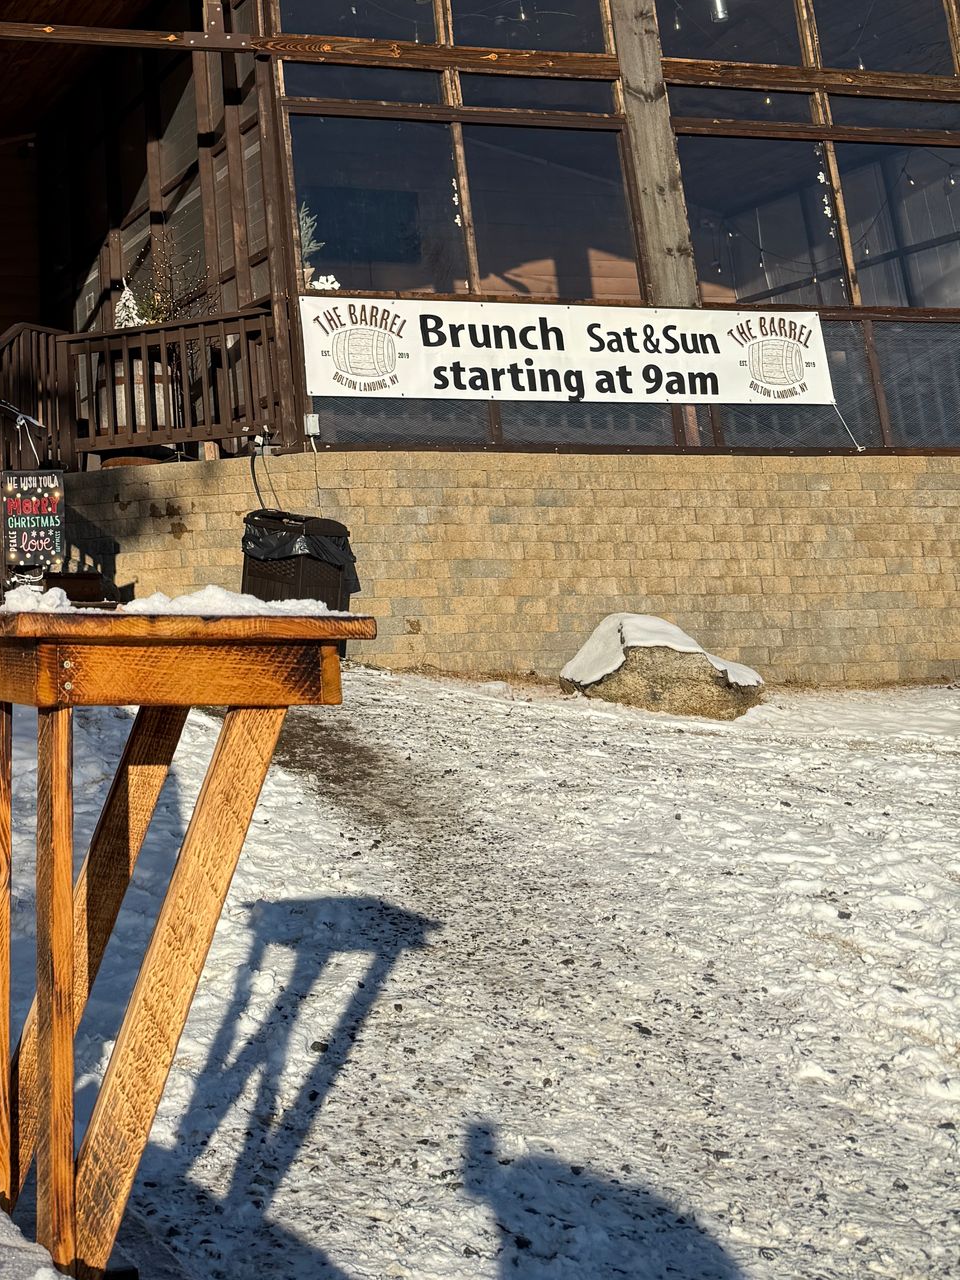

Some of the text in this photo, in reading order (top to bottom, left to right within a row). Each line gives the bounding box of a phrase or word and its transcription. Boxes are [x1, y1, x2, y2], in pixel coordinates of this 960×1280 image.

[313, 304, 407, 338] THE BARREL
[419, 314, 565, 351] Brunch
[727, 316, 812, 348] THE BARREL
[332, 371, 399, 392] BOLTON LANDING, NY
[433, 358, 720, 402] starting at 9am
[749, 380, 771, 397] BOLTON
[799, 382, 808, 393] NY
[7, 477, 18, 489] WE
[20, 477, 37, 488] WISH
[8, 515, 61, 529] CHRISTMAS
[8, 531, 17, 552] PEACE
[20, 531, 53, 552] love
